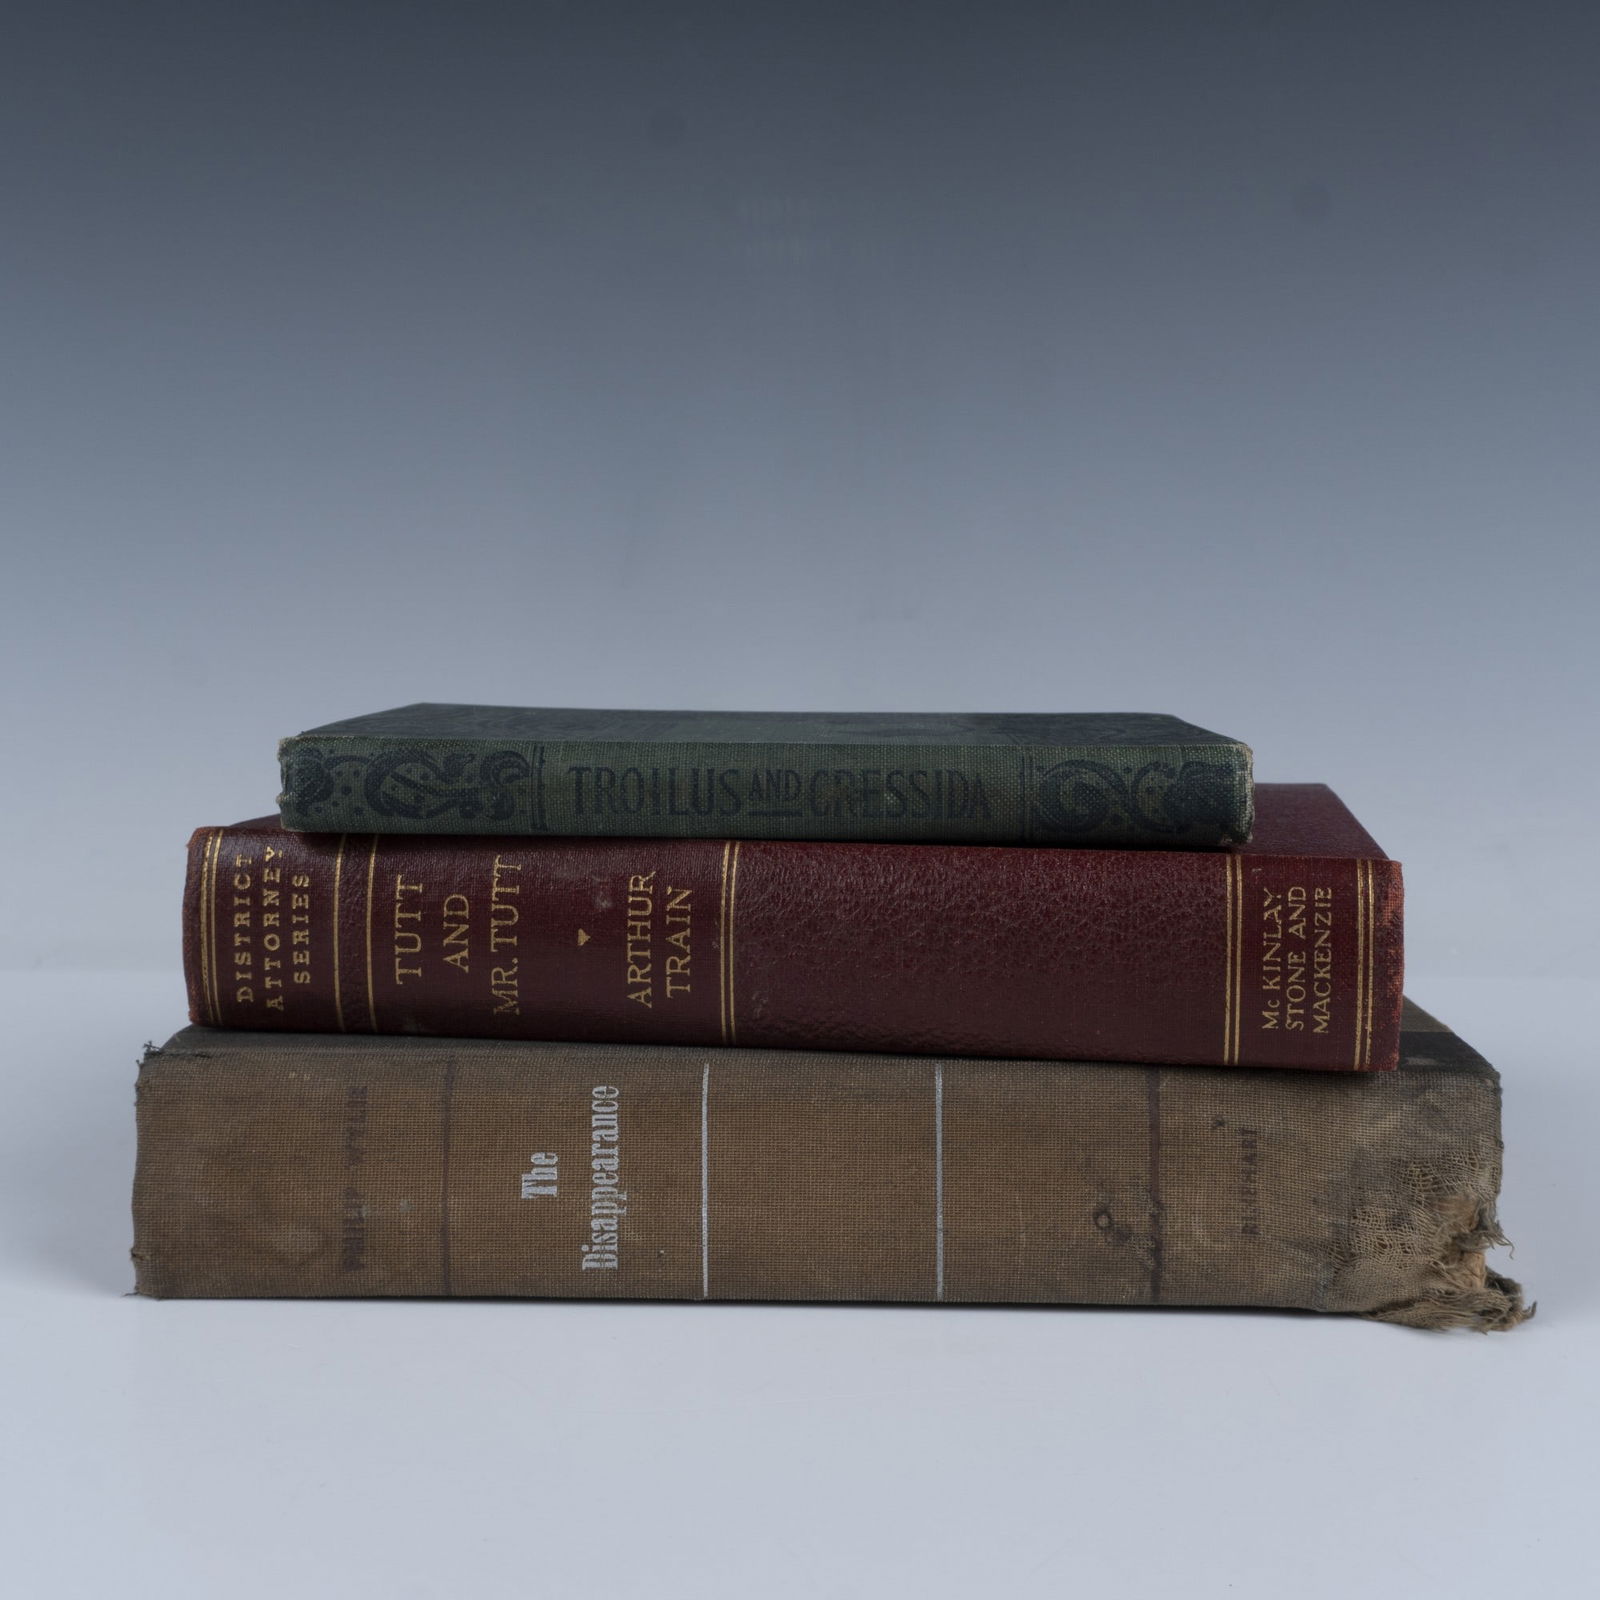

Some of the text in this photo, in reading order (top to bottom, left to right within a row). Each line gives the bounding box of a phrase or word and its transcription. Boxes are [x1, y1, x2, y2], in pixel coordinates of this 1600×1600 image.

[571, 764, 991, 820] TROILUS AND CRESSIDA
[234, 854, 254, 1003] DISTRICT
[263, 846, 284, 1011] ATTORNEY
[292, 873, 311, 984] SERIES
[394, 875, 423, 985] TUTT
[443, 893, 470, 973] AND
[490, 854, 522, 1015] MR. TUTT
[627, 870, 656, 1008] ARTHUR
[666, 885, 693, 998] TRAIN
[1285, 886, 1307, 1031] STONE AND
[1313, 887, 1332, 1033] MACKENZIE
[521, 1152, 559, 1199] The
[581, 1085, 627, 1270] Disappearance
